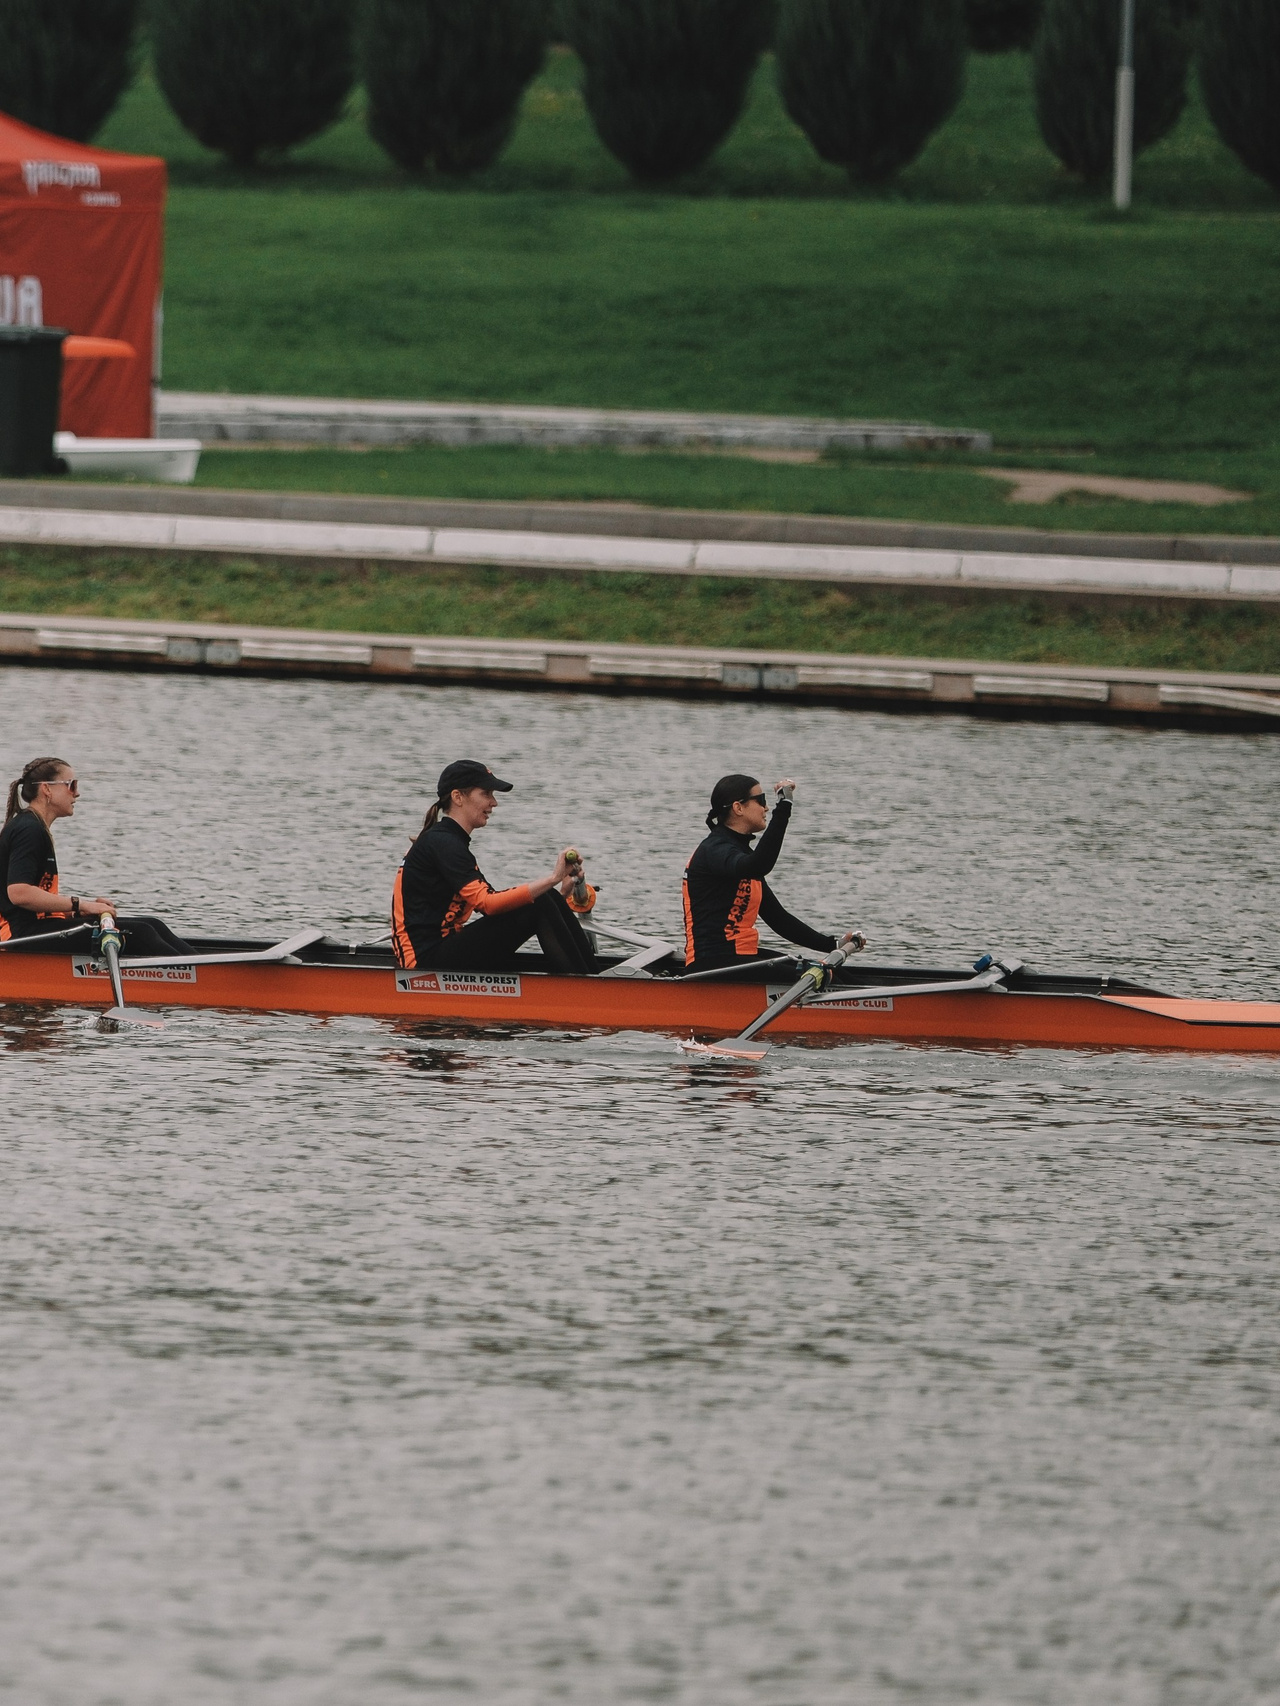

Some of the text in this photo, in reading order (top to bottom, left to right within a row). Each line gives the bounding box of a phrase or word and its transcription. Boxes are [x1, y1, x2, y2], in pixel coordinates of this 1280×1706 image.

[121, 969, 164, 979] ROWING
[166, 971, 192, 980] CLUB
[442, 974, 518, 985] SILVER FOREST
[413, 980, 437, 989] SFRC
[444, 983, 516, 994] ROWING CLUB
[862, 1000, 888, 1009] CLUB
